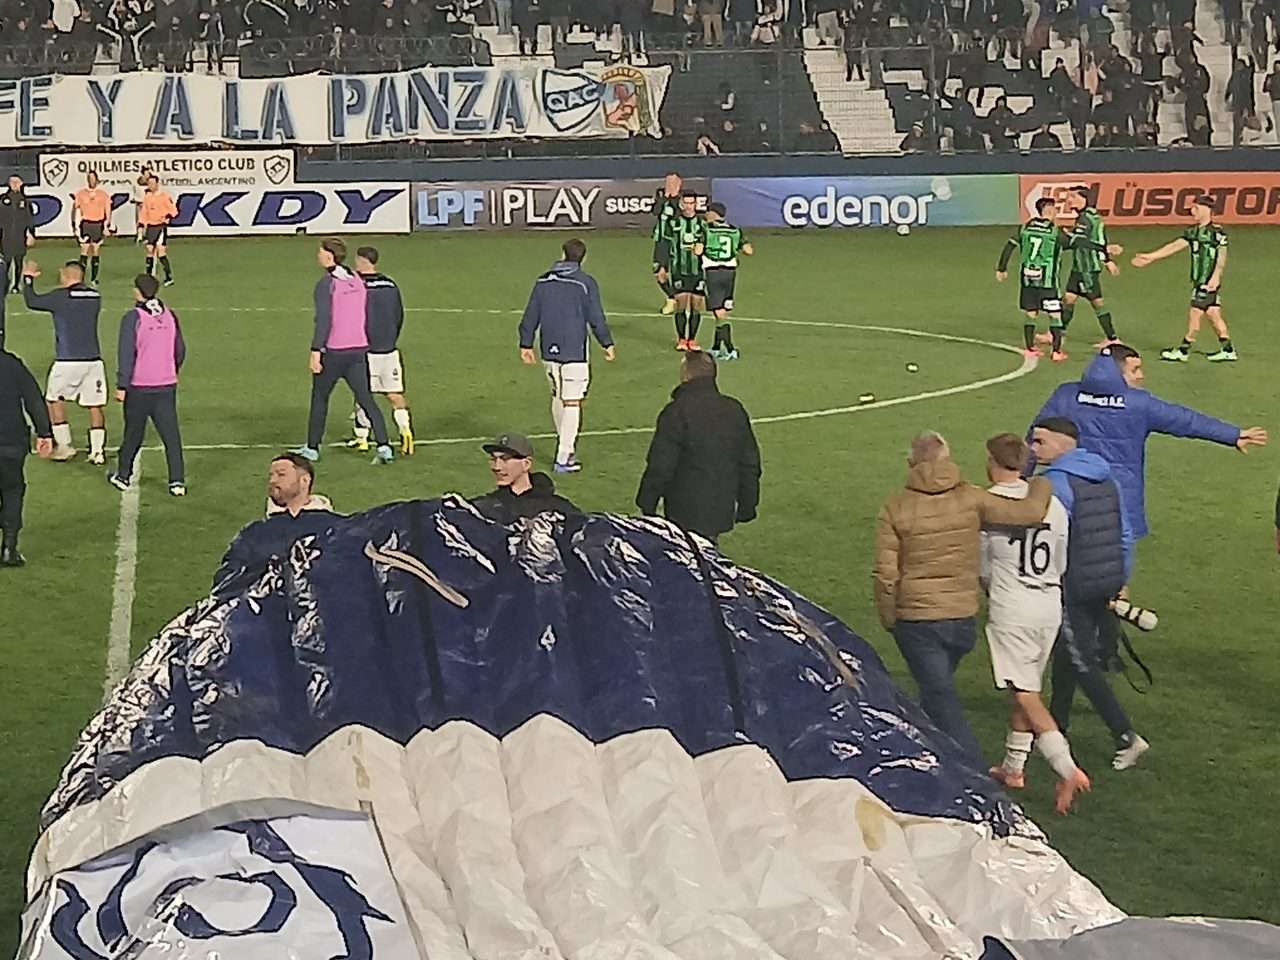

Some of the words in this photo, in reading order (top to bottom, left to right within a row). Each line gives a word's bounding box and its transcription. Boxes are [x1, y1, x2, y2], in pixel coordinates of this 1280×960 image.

[86, 80, 123, 143] Y
[147, 76, 196, 140] A
[223, 80, 297, 143] LA
[327, 68, 528, 138] PANZA
[77, 159, 145, 173] QUILMES
[218, 158, 255, 171] CLUB
[417, 190, 484, 226] LPF
[503, 188, 600, 225] PLAY
[783, 186, 934, 226] edenor
[1030, 237, 1043, 261] 7
[1008, 523, 1051, 575] 16
